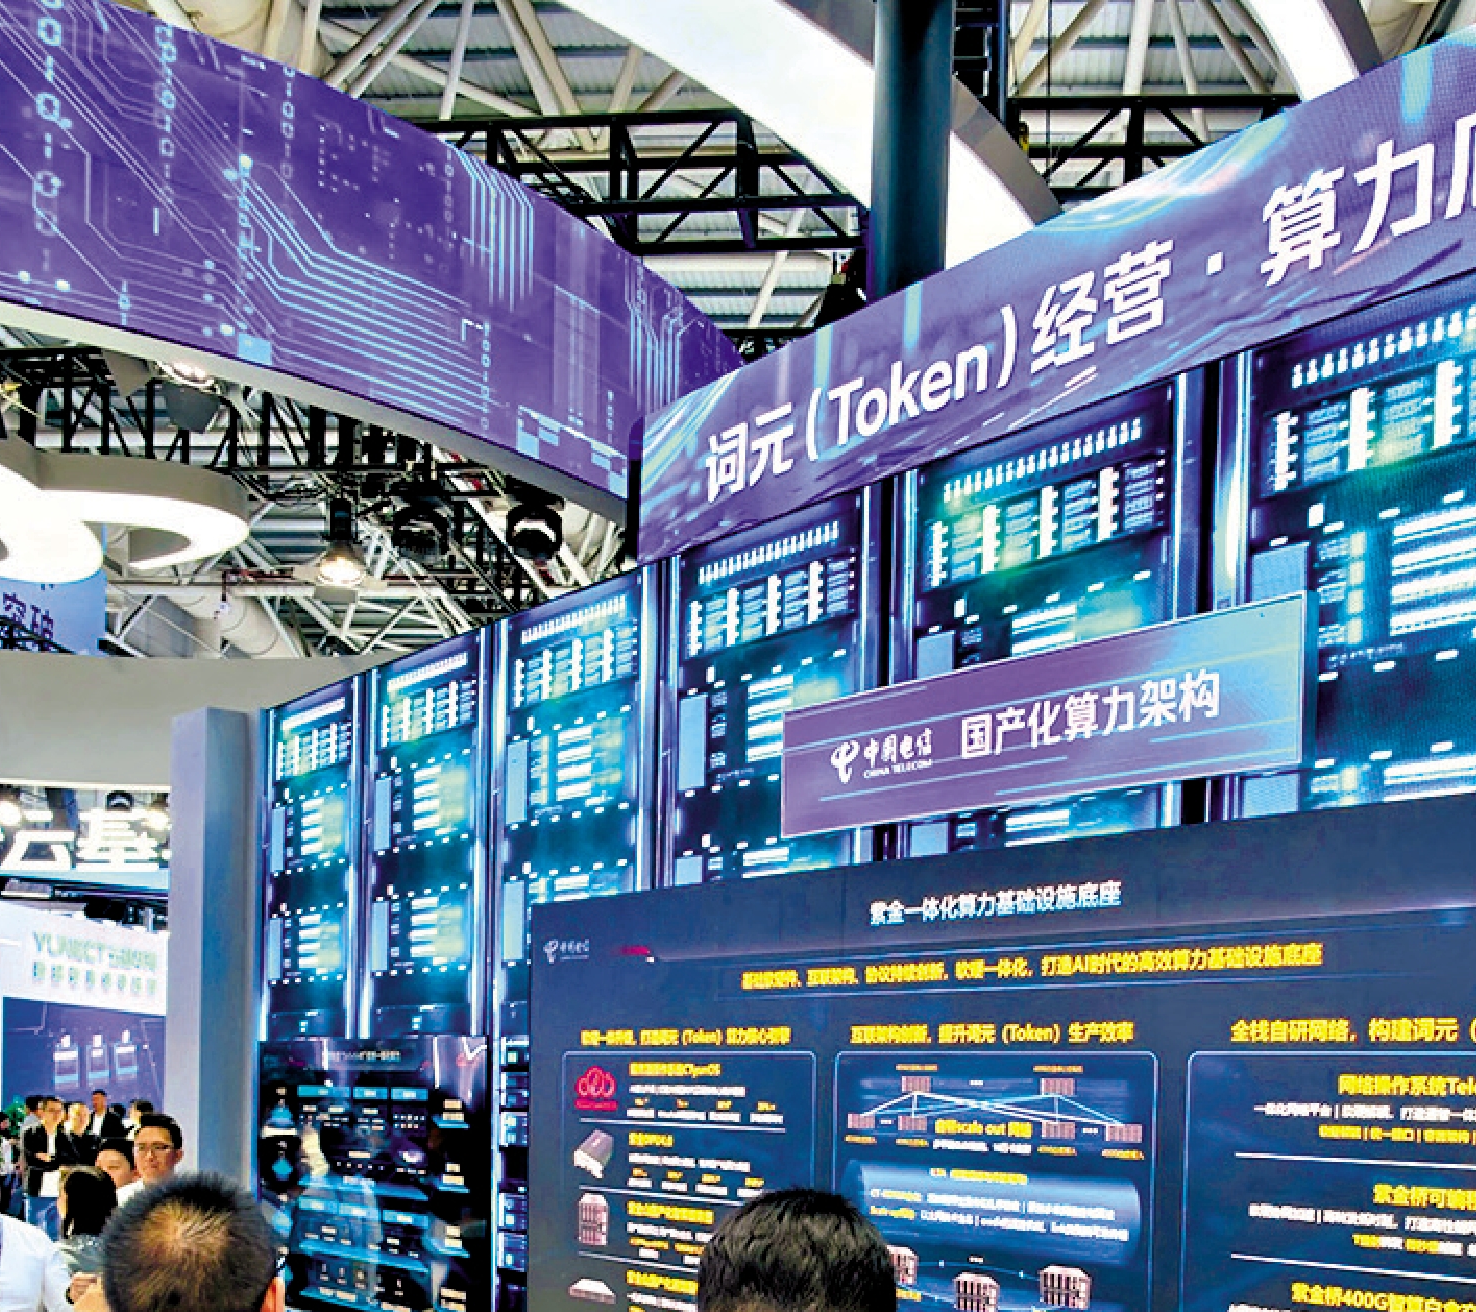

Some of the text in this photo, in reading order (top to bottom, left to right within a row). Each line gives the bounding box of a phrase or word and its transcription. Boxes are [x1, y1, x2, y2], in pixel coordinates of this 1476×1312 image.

[961, 668, 1220, 758] 国产化算力架构
